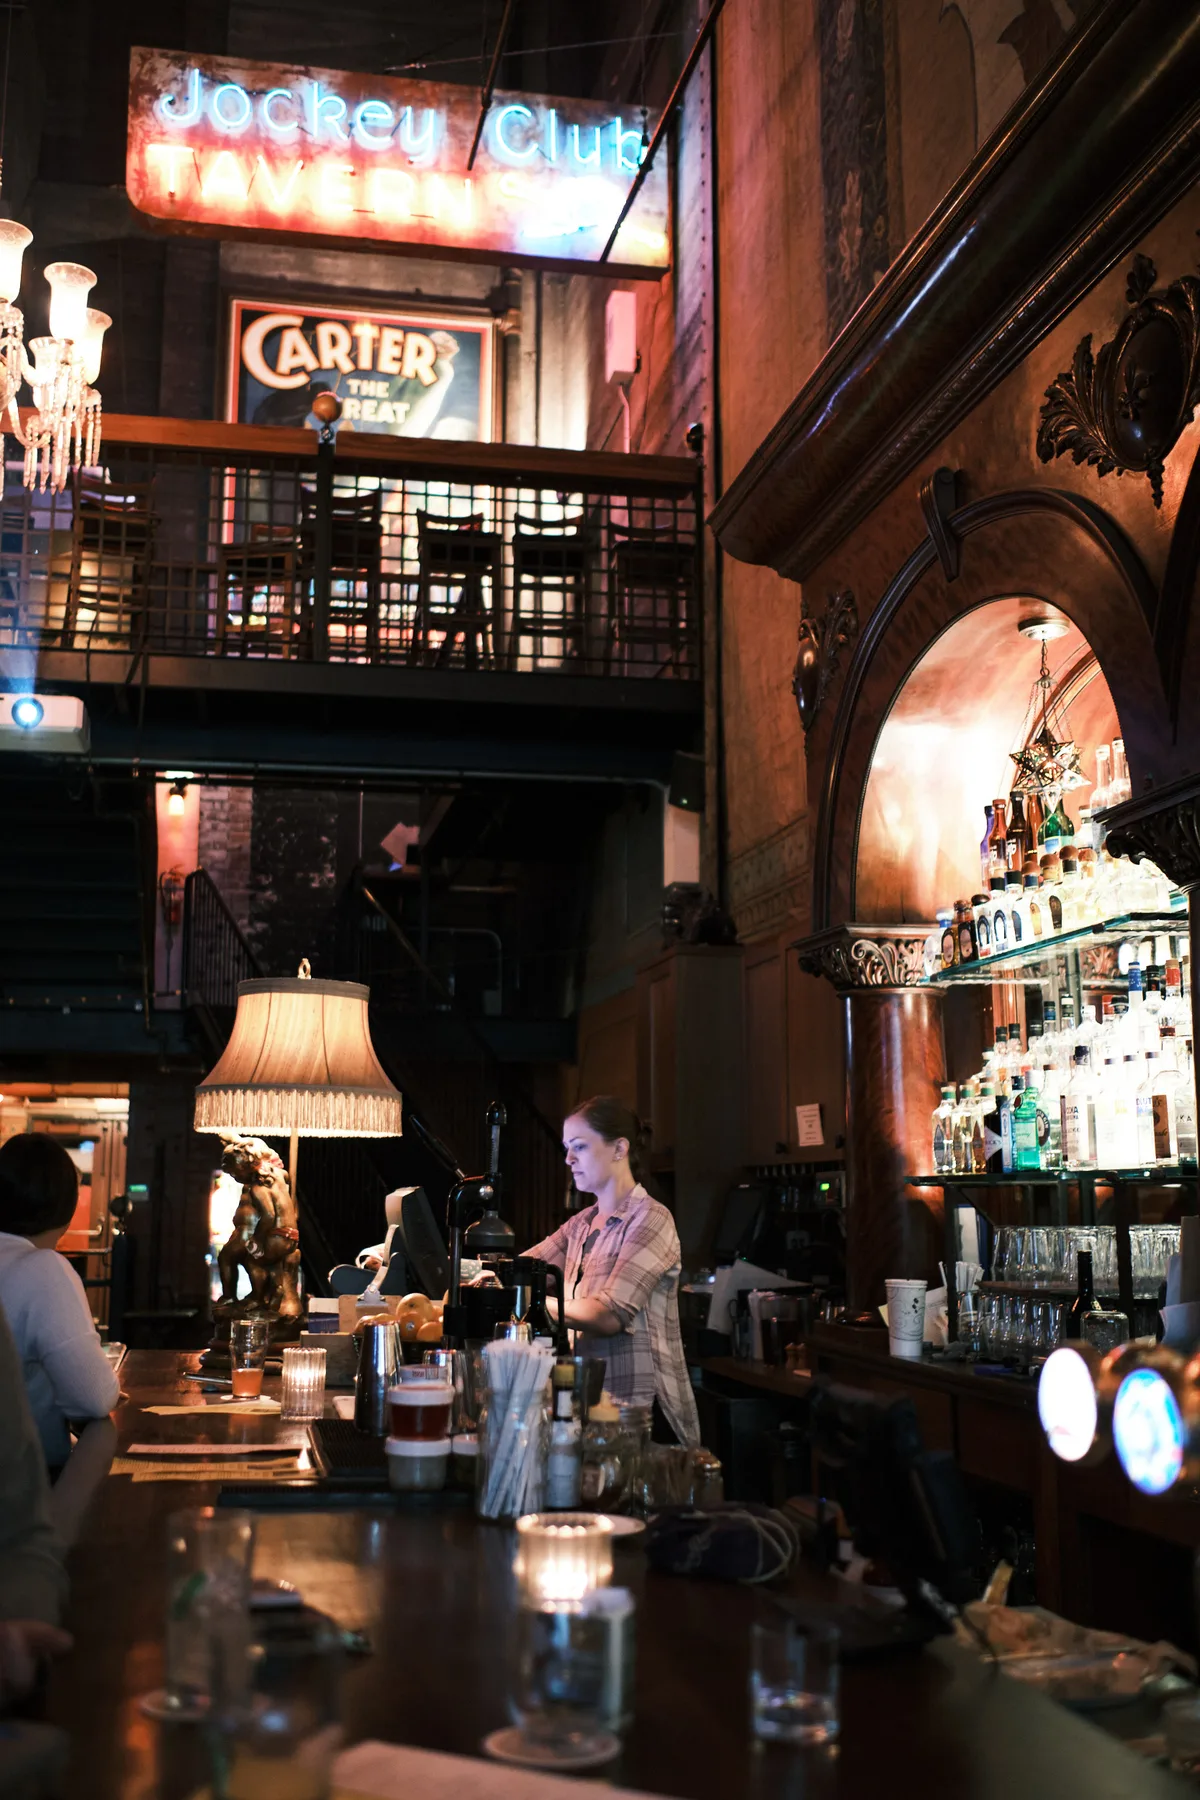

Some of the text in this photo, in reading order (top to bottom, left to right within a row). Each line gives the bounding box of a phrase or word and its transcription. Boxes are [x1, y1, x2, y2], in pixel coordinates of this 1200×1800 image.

[159, 67, 651, 171] Jockey Club
[146, 143, 476, 224] TAVERN
[241, 313, 440, 390] CARTER
[346, 377, 390, 398] THE
[340, 398, 411, 424] REAT
